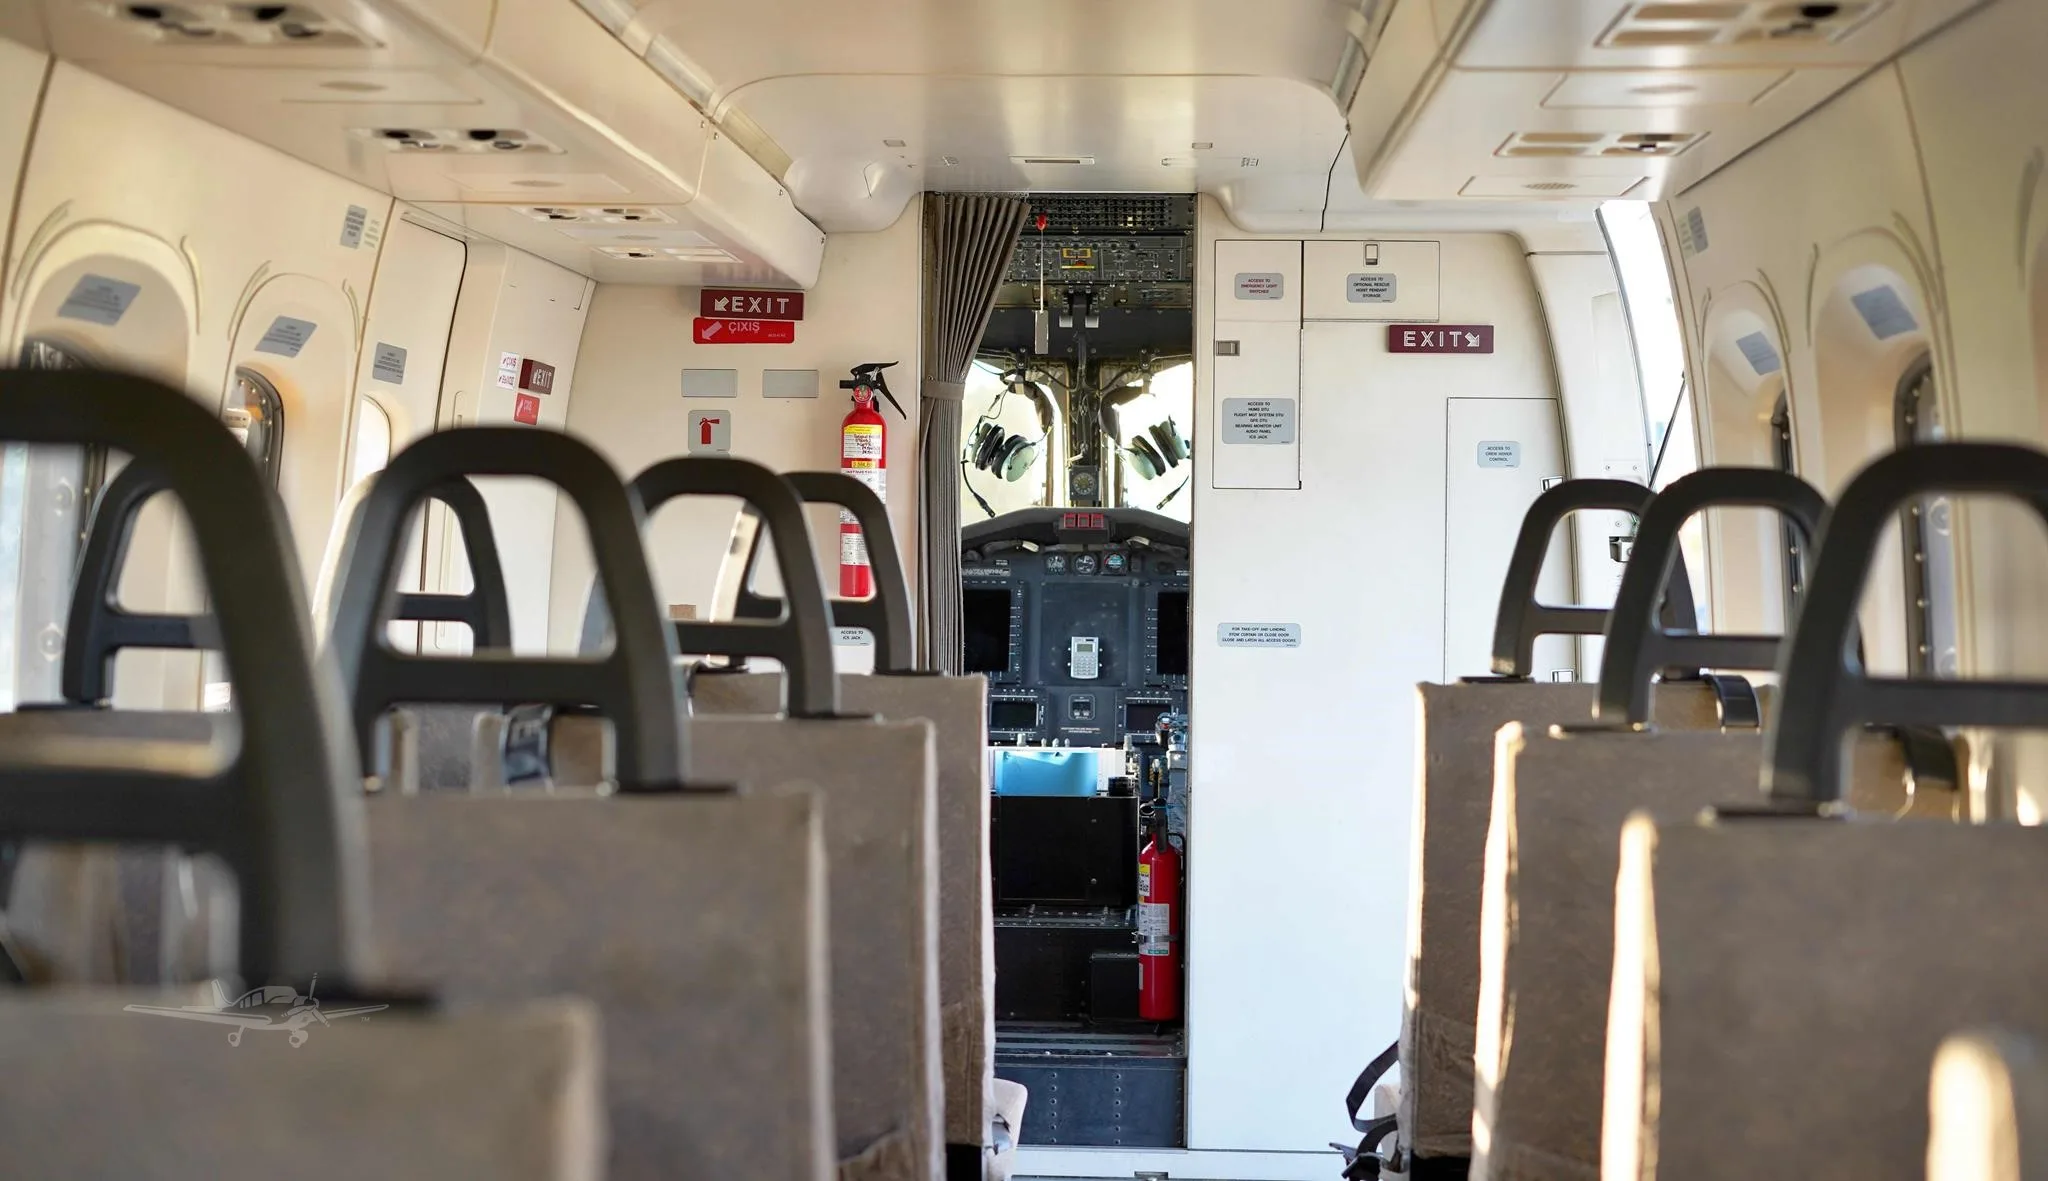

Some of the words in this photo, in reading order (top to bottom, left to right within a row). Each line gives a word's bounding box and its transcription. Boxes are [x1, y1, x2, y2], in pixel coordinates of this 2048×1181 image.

[732, 296, 790, 314] EXIT
[728, 322, 760, 334] ÇIXIŞ
[1403, 331, 1462, 347] EXIT
